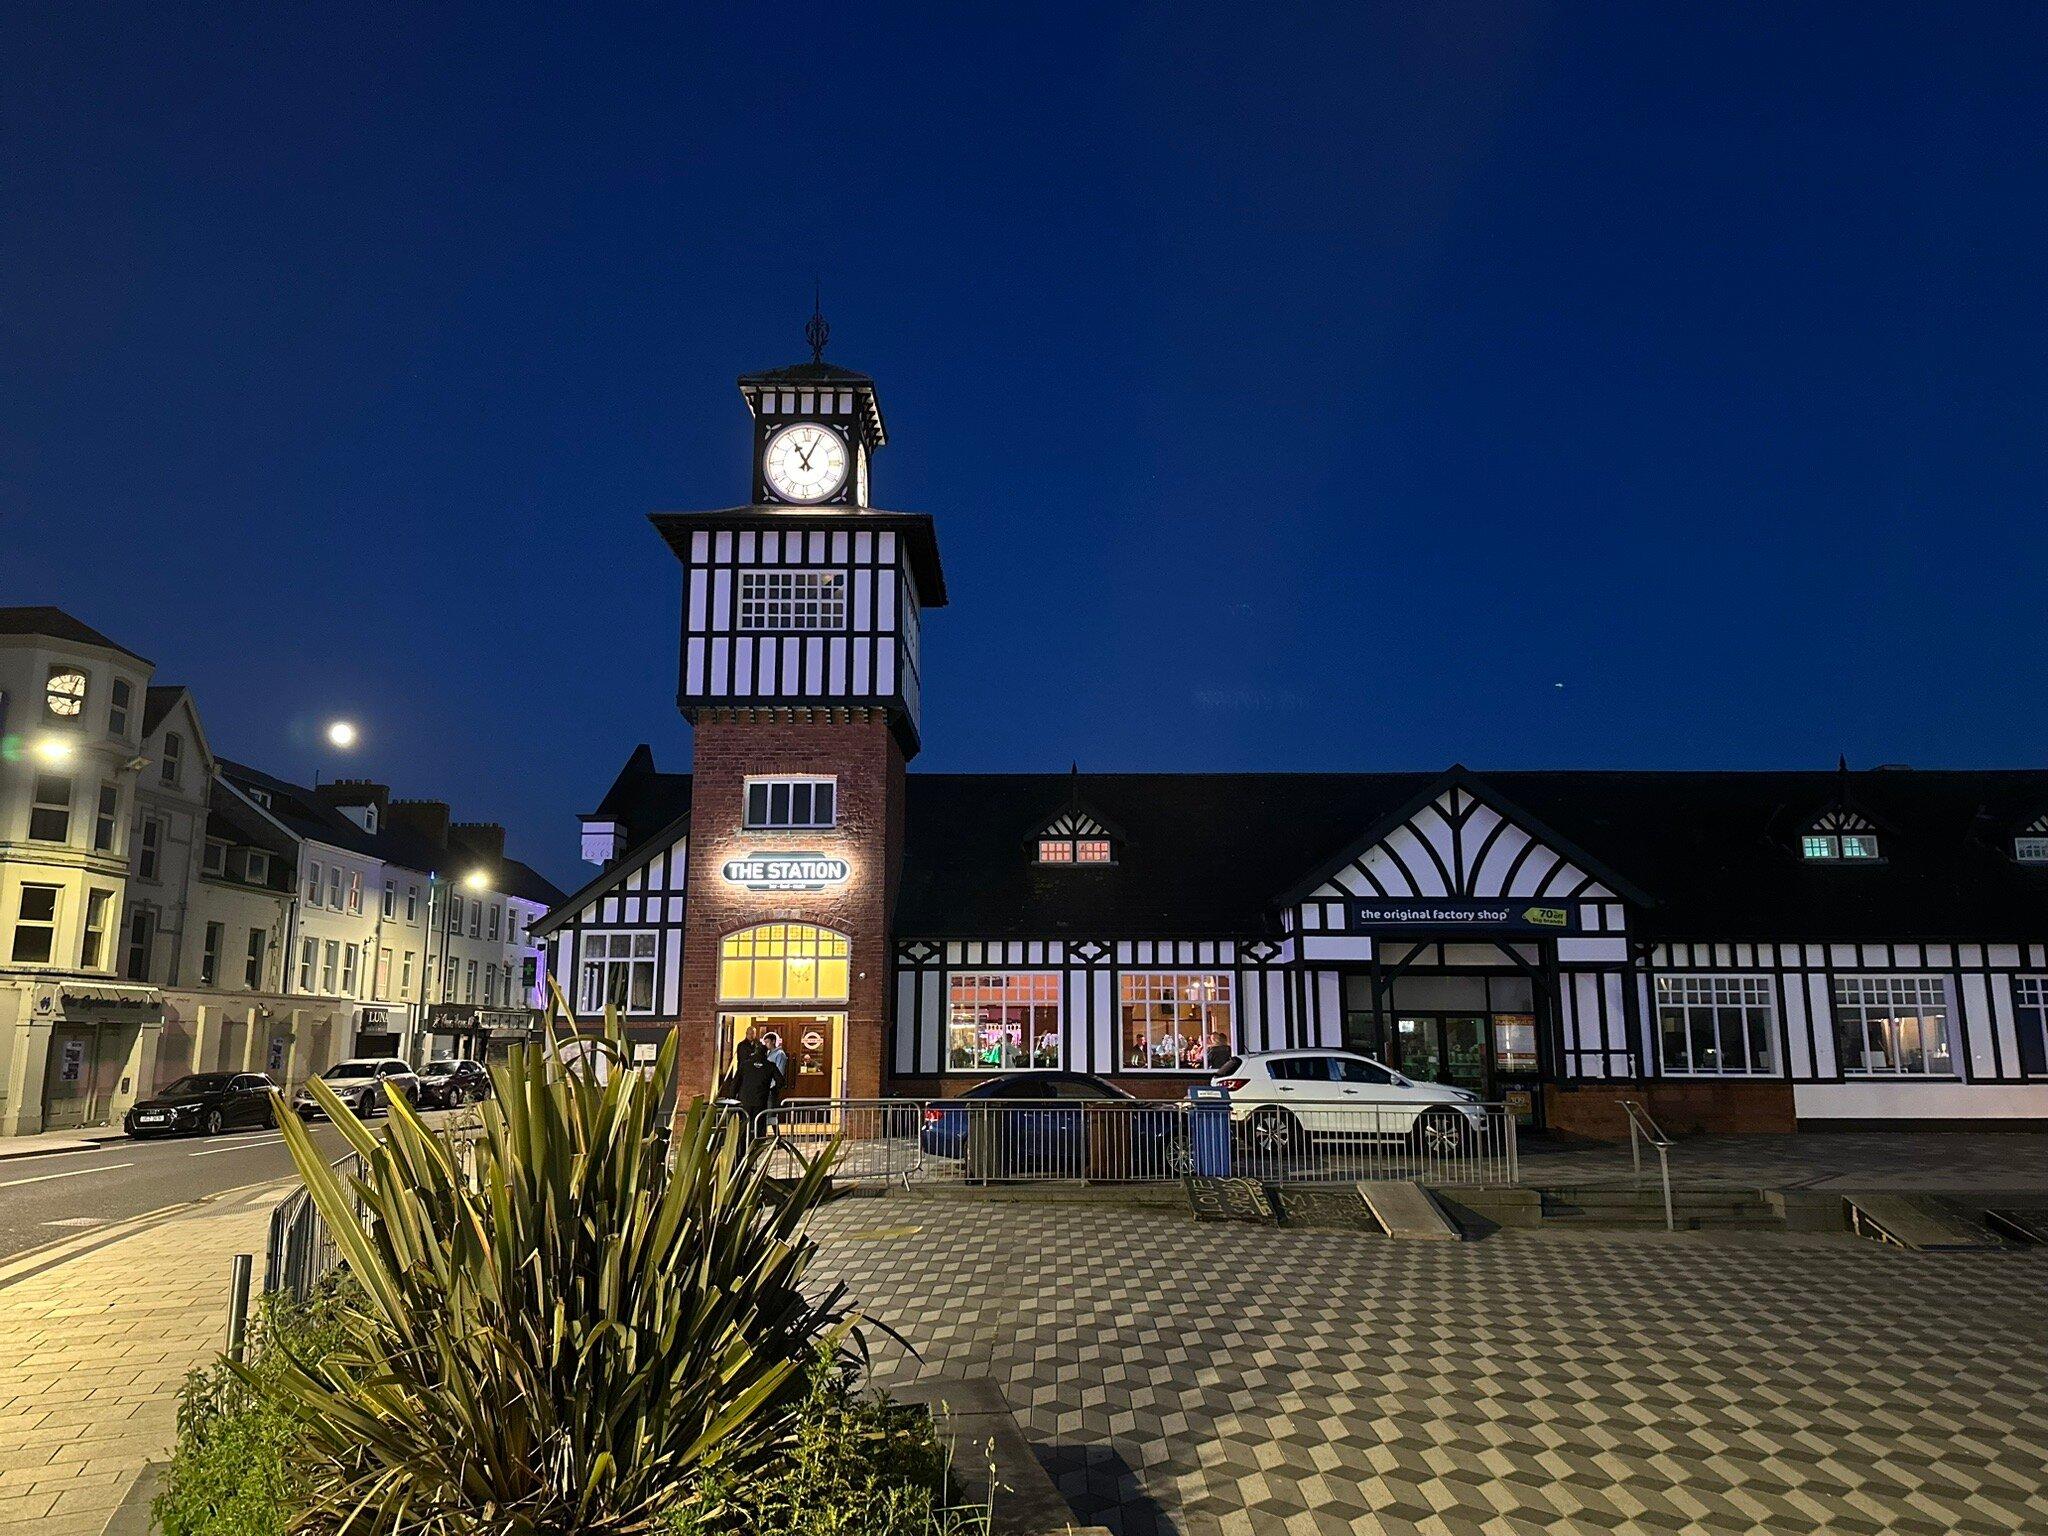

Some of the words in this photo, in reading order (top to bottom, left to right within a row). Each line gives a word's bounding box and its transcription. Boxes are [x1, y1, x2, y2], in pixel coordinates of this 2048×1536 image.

[728, 862, 764, 879] THE
[767, 862, 841, 879] STATION
[1361, 909, 1381, 919] the
[1383, 909, 1431, 921] original
[1433, 909, 1475, 922] factory
[1477, 909, 1507, 921] shop
[1192, 1180, 1224, 1212] LOVE
